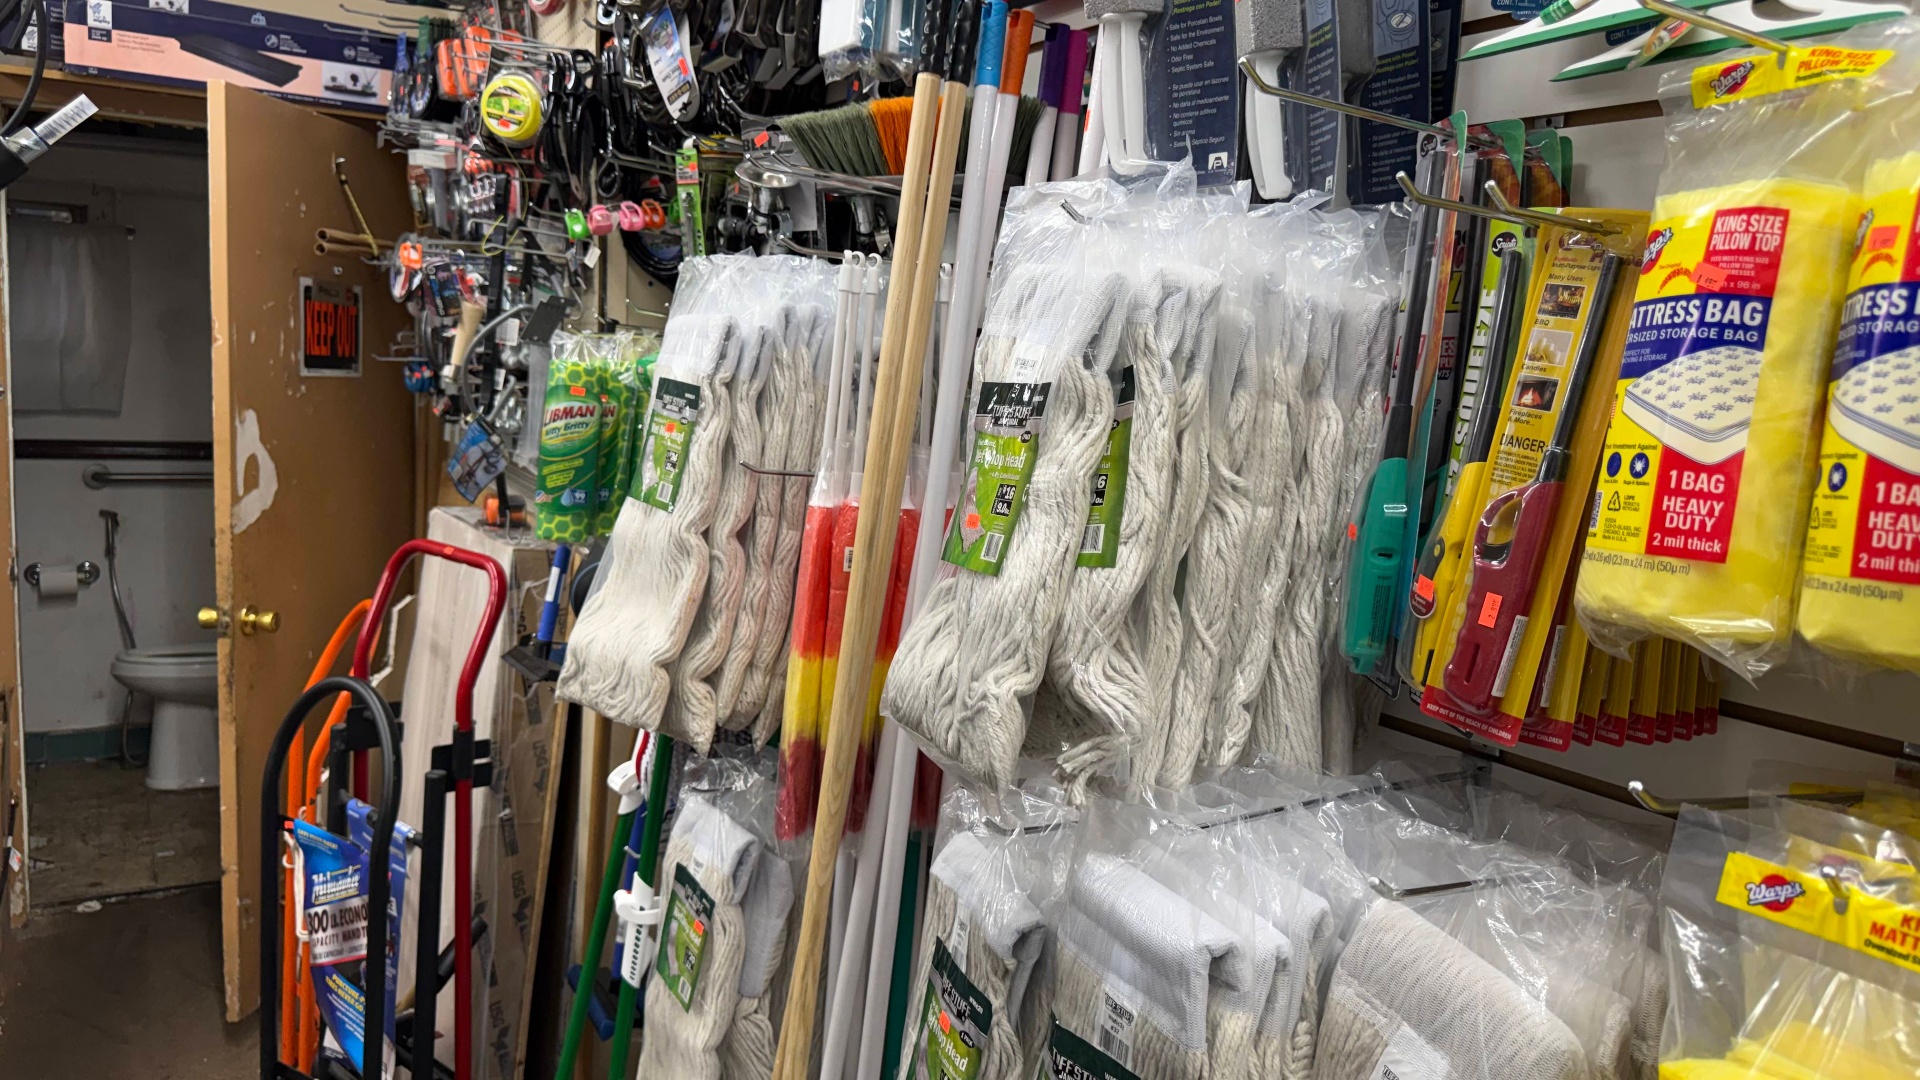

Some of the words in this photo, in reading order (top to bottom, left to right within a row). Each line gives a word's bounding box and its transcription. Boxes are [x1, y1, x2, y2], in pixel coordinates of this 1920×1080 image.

[1169, 23, 1180, 31] Safe
[1187, 18, 1208, 28] Porcelain
[1208, 15, 1223, 23] Bowls
[1170, 34, 1181, 42] Safe
[1196, 26, 1225, 37] Environment
[1193, 38, 1217, 48] Chemicals
[1610, 31, 1627, 41] CONT.
[1182, 53, 1194, 61] Free
[1808, 48, 1843, 59] KING
[1842, 50, 1876, 61] SIZE
[1186, 62, 1203, 71] System
[1203, 60, 1215, 68] Safe
[1796, 58, 1843, 74] PILLOW
[1846, 60, 1876, 68] TOP
[1179, 82, 1193, 90] puede
[1710, 60, 1755, 98] Warp's
[1179, 89, 1201, 98] porcelana
[1180, 110, 1199, 118] contiene
[1208, 136, 1225, 144] Seguro
[1714, 214, 1747, 234] KING
[1748, 214, 1785, 234] SIZE
[1709, 232, 1753, 251] PILLOW
[1755, 233, 1781, 252] TOP
[1548, 273, 1565, 281] Many
[1566, 274, 1584, 282] Uses:
[1736, 281, 1750, 289] 96
[1751, 280, 1761, 290] in
[1629, 299, 1702, 329] ATTRESS
[1703, 298, 1764, 327] BAG
[305, 300, 335, 357] KEEP
[337, 304, 358, 358] OUT
[1659, 327, 1719, 340] STORAGE
[1723, 329, 1759, 343] BAG
[1857, 320, 1919, 334] STORAG
[1642, 353, 1668, 362] STORAGE
[1521, 363, 1547, 373] Candles
[544, 405, 596, 427] LIBMAN
[993, 405, 1010, 417] TUFF
[1009, 406, 1033, 419] STUFF
[1509, 408, 1543, 420] Fireplaces
[563, 420, 591, 433] Gritty
[1499, 433, 1549, 454] DANGER:
[1637, 443, 1658, 451] Against
[1003, 447, 1027, 471] Head
[1669, 469, 1678, 489] 1
[1680, 471, 1726, 494] BAG
[1875, 482, 1887, 504] 1
[1662, 495, 1725, 518] HEAVY
[1664, 512, 1716, 533] DUTY
[1868, 510, 1920, 533] HEAV
[1652, 532, 1662, 546] 2
[1663, 535, 1685, 549] mil
[1687, 536, 1722, 553] thick
[1857, 552, 1869, 569] 2
[1870, 555, 1895, 572] mil
[1898, 558, 1920, 576] thi
[1426, 702, 1438, 712] KEEP
[1438, 707, 1449, 717] OUT
[1449, 711, 1456, 719] OF
[1456, 713, 1465, 723] THE
[1465, 717, 1481, 729] REACH
[1481, 722, 1488, 731] OF
[1488, 725, 1512, 741] CHILDREN
[1536, 732, 1564, 745] CHILDREN
[532, 740, 548, 768] USG
[511, 870, 527, 899] USG
[1745, 880, 1806, 906] Warp's
[340, 904, 368, 926] ECONO
[342, 926, 362, 943] HAND
[1869, 921, 1920, 953] MATT
[1864, 938, 1911, 962] Oversized
[950, 989, 972, 1017] STUFF
[1116, 1003, 1134, 1023] STUFF
[489, 1000, 506, 1029] USG
[963, 1035, 974, 1048] PACK
[945, 1039, 969, 1072] Head
[1052, 1046, 1074, 1074] TUFF
